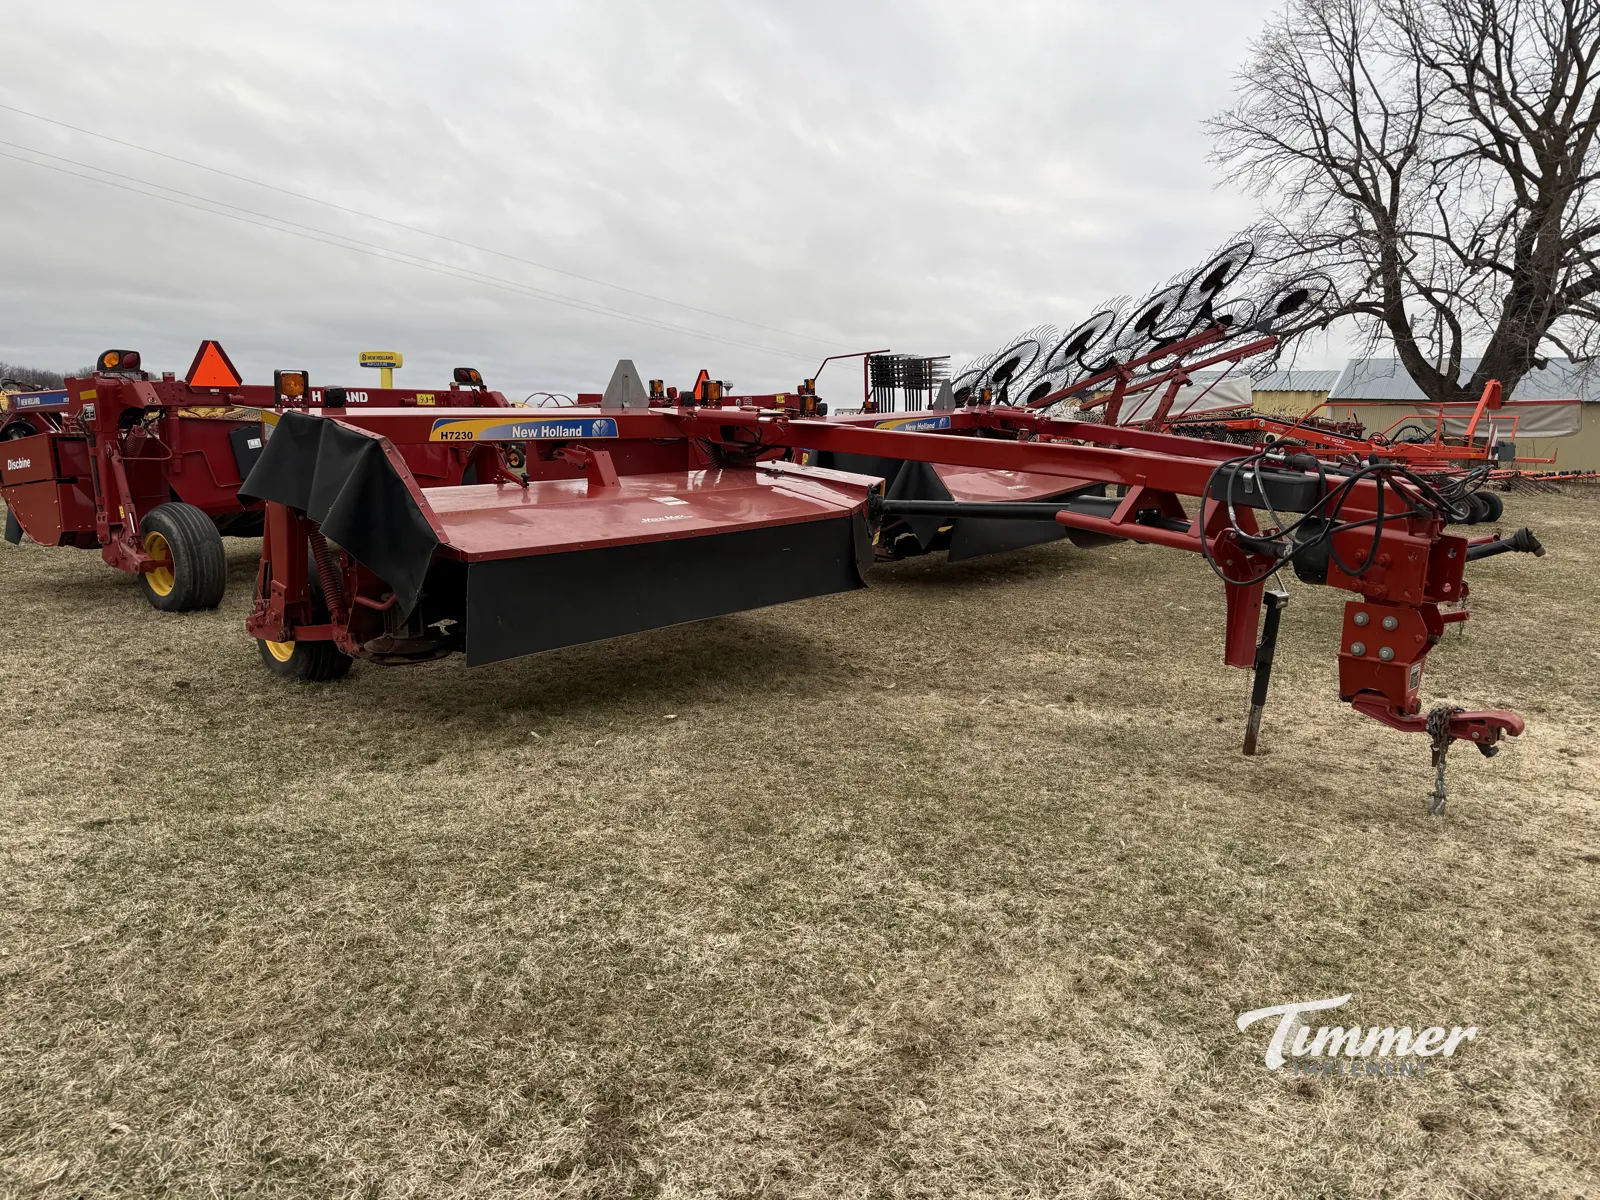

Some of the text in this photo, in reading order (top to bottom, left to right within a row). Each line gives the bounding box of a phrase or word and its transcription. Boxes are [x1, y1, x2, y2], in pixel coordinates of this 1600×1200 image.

[311, 390, 368, 403] HAND
[441, 425, 583, 440] H7230 New Holland
[917, 422, 936, 431] Holland
[7, 457, 30, 470] Discbine
